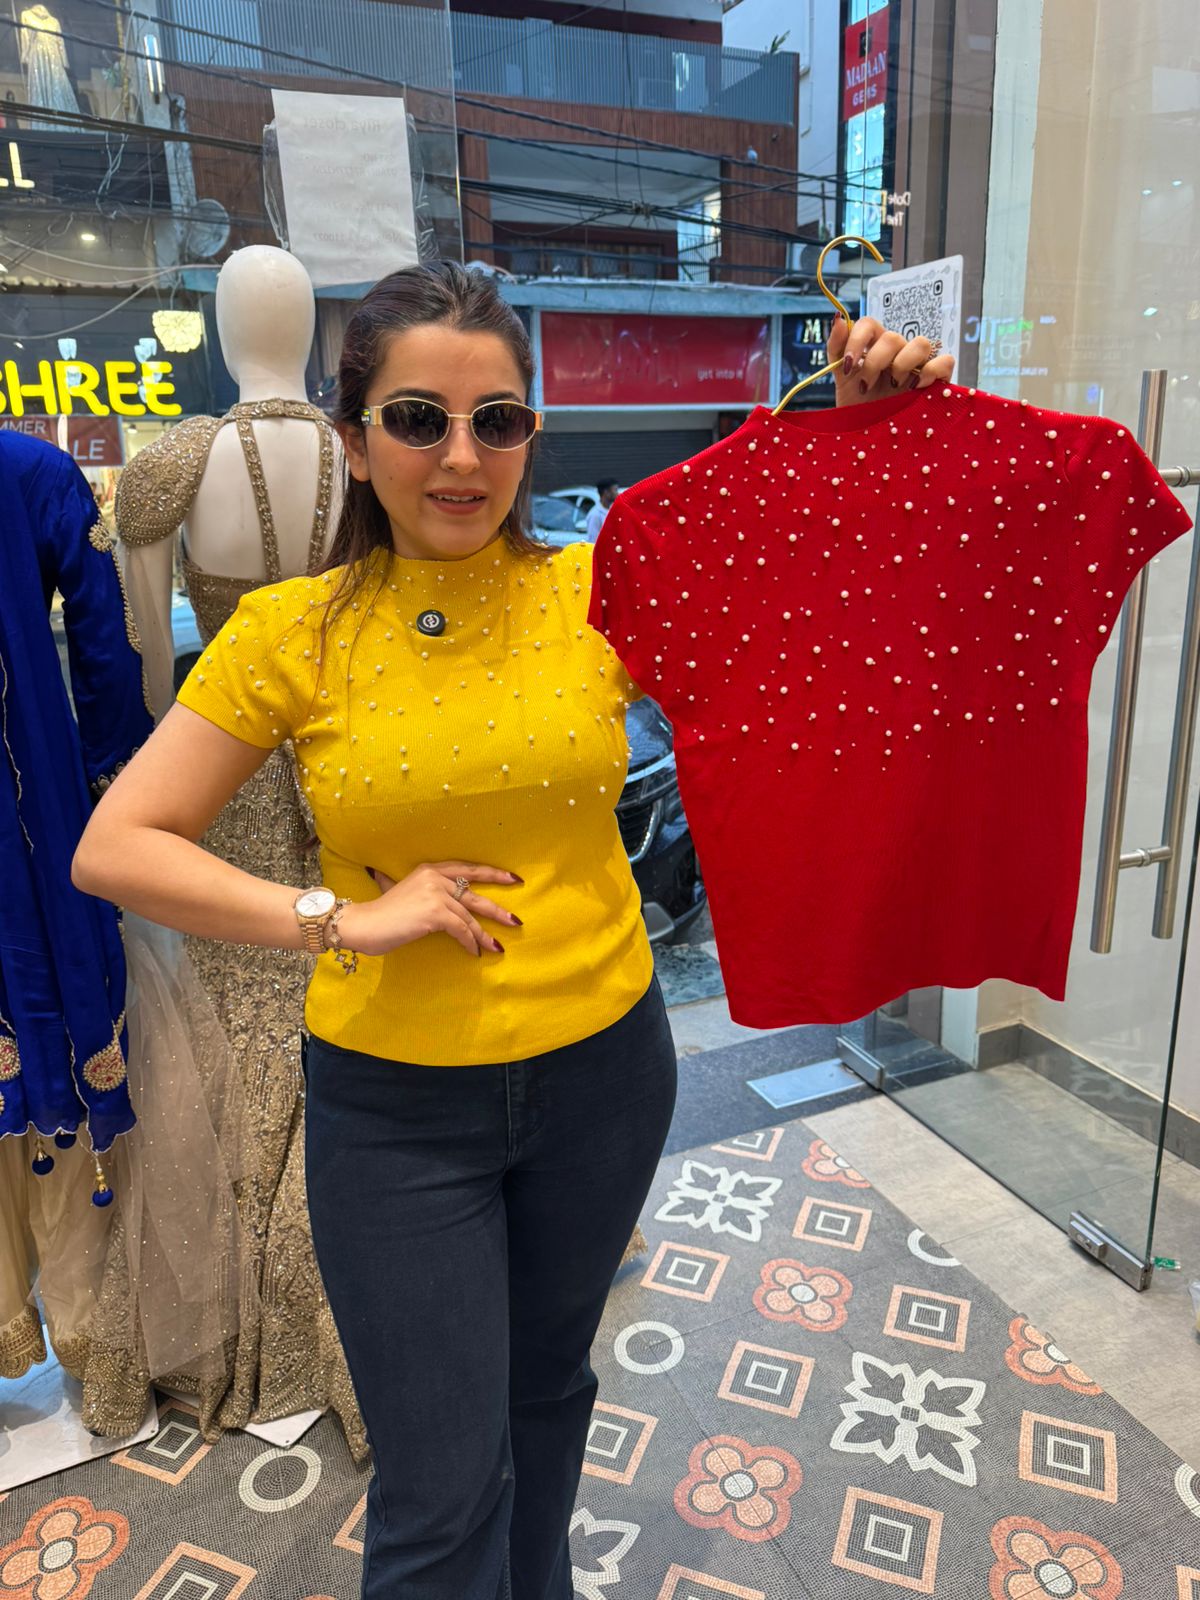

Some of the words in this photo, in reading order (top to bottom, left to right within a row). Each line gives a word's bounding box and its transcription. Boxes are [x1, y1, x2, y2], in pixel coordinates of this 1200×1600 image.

[0, 142, 35, 188] L
[803, 318, 829, 343] M
[68, 439, 105, 460] LE
